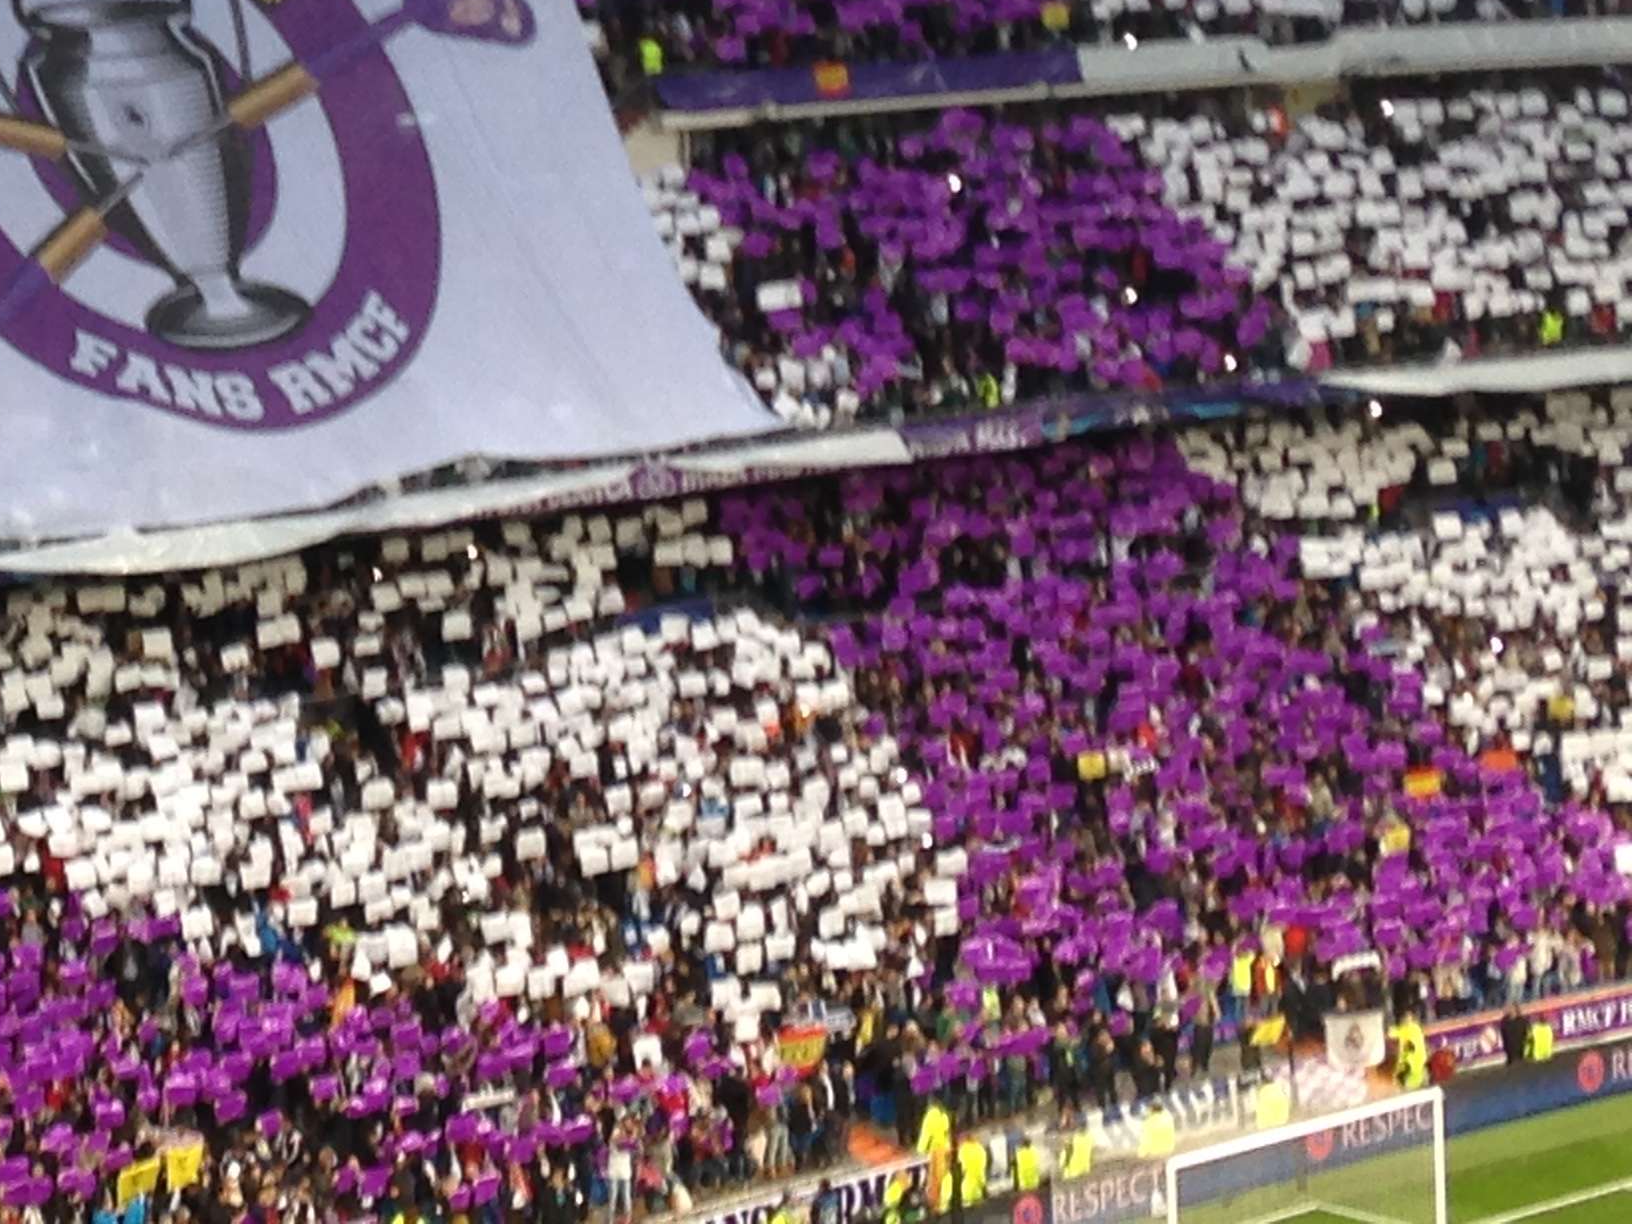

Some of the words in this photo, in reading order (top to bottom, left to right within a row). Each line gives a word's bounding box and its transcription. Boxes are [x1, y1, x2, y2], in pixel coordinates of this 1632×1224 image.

[70, 329, 265, 422] FANS
[269, 288, 412, 416] RMCF
[1342, 1102, 1435, 1150] RESPEC
